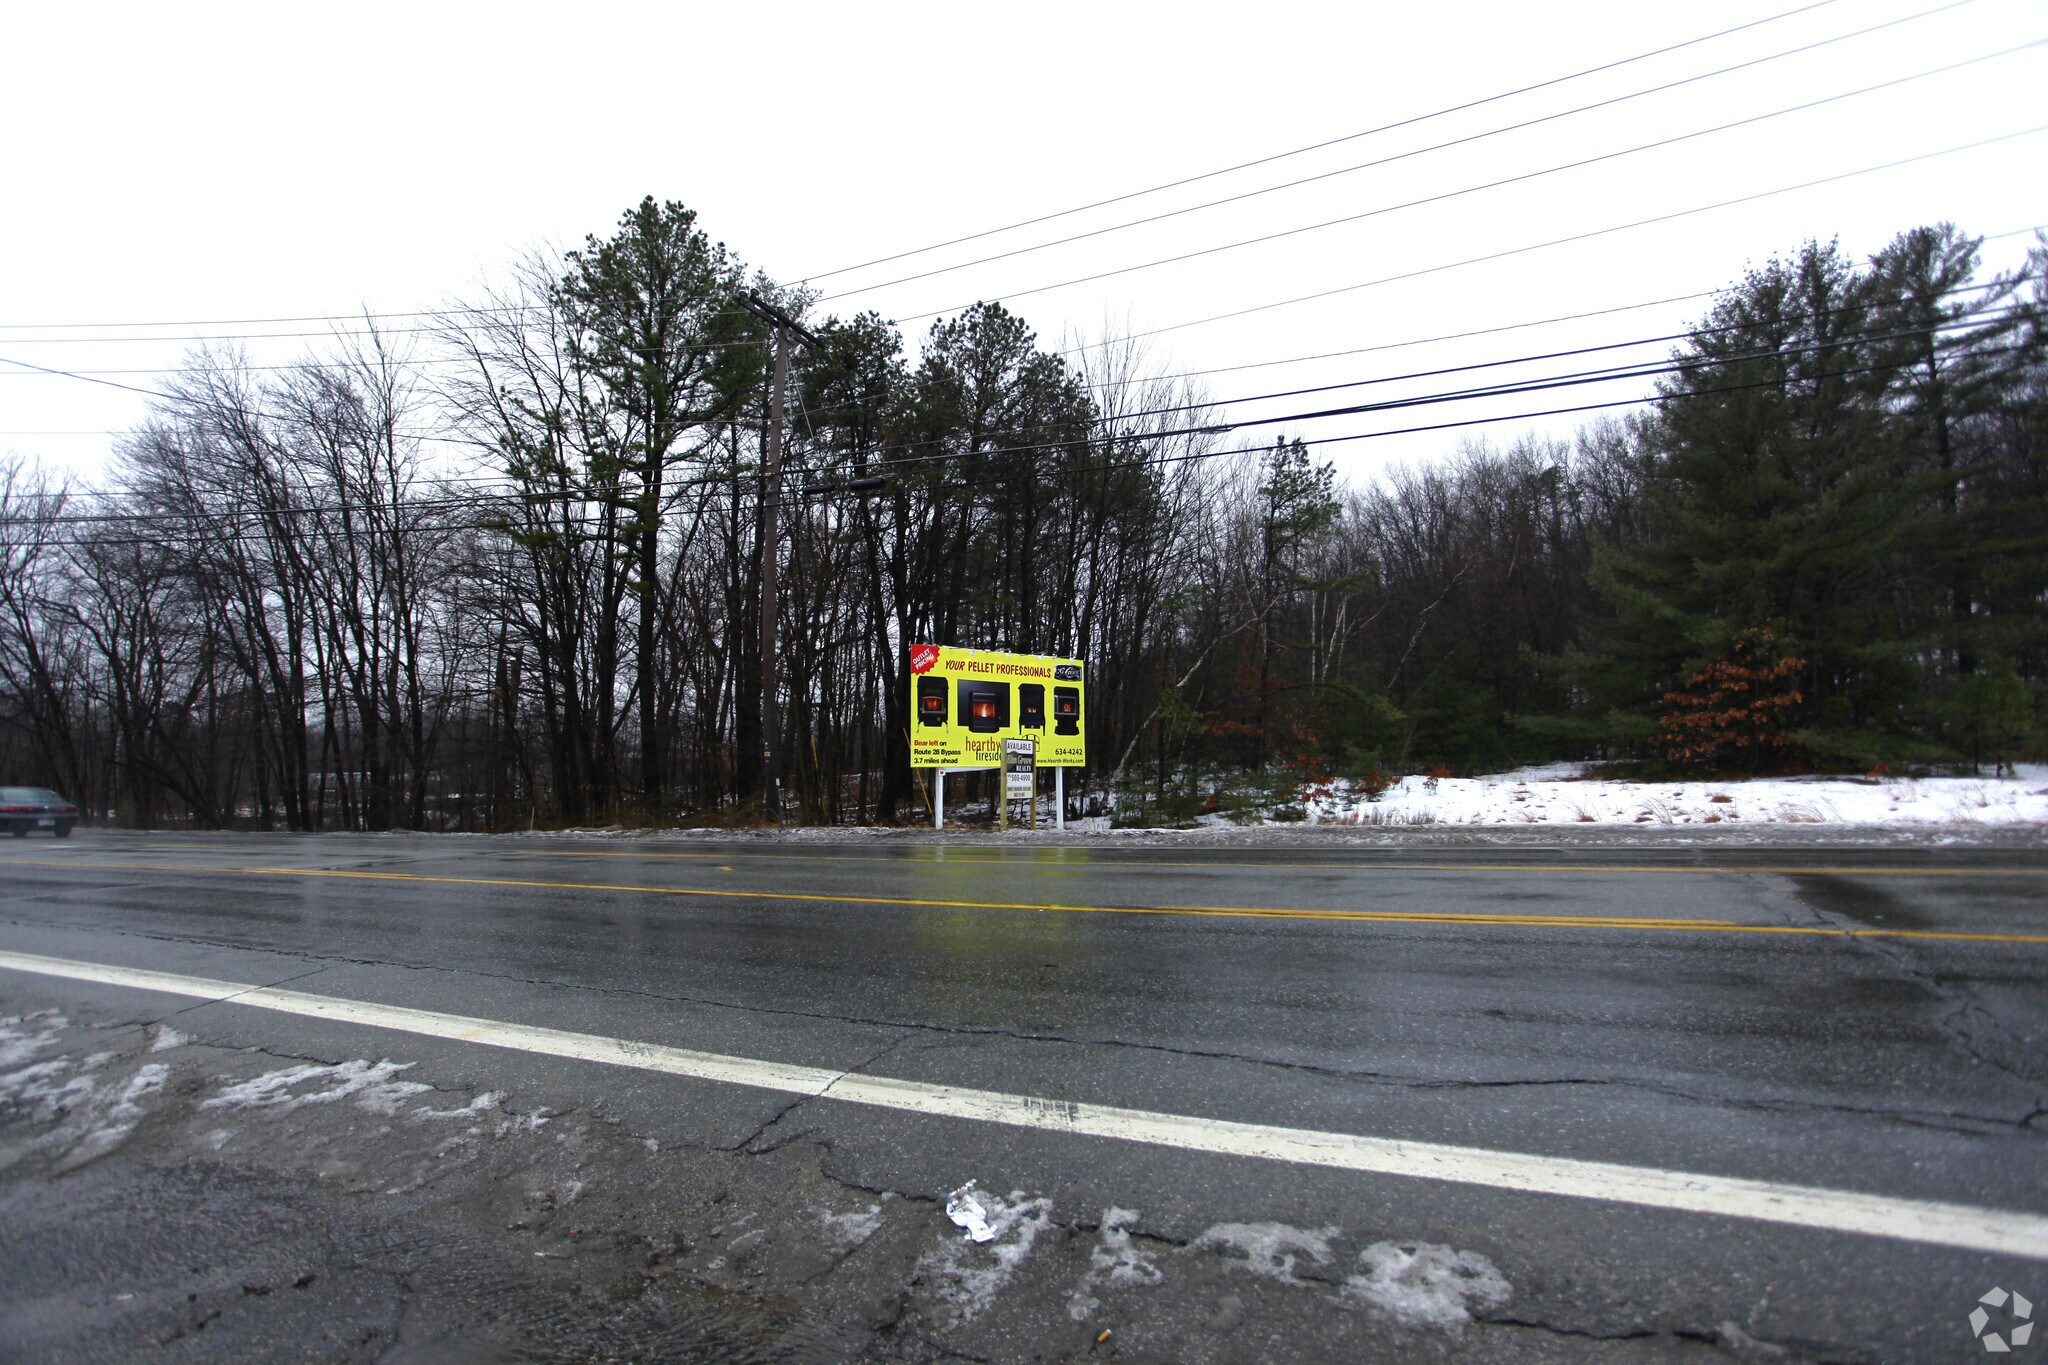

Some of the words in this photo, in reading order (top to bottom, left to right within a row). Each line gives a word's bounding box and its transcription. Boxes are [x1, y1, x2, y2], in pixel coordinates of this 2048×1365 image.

[913, 648, 930, 664] OUTLET
[915, 653, 934, 669] PRICING
[945, 659, 965, 670] YOUR
[968, 660, 994, 673] PELLET
[996, 663, 1051, 678] PROFESSIONALS
[965, 736, 1001, 751] hearthw
[1007, 742, 1031, 751] AVAILABLE
